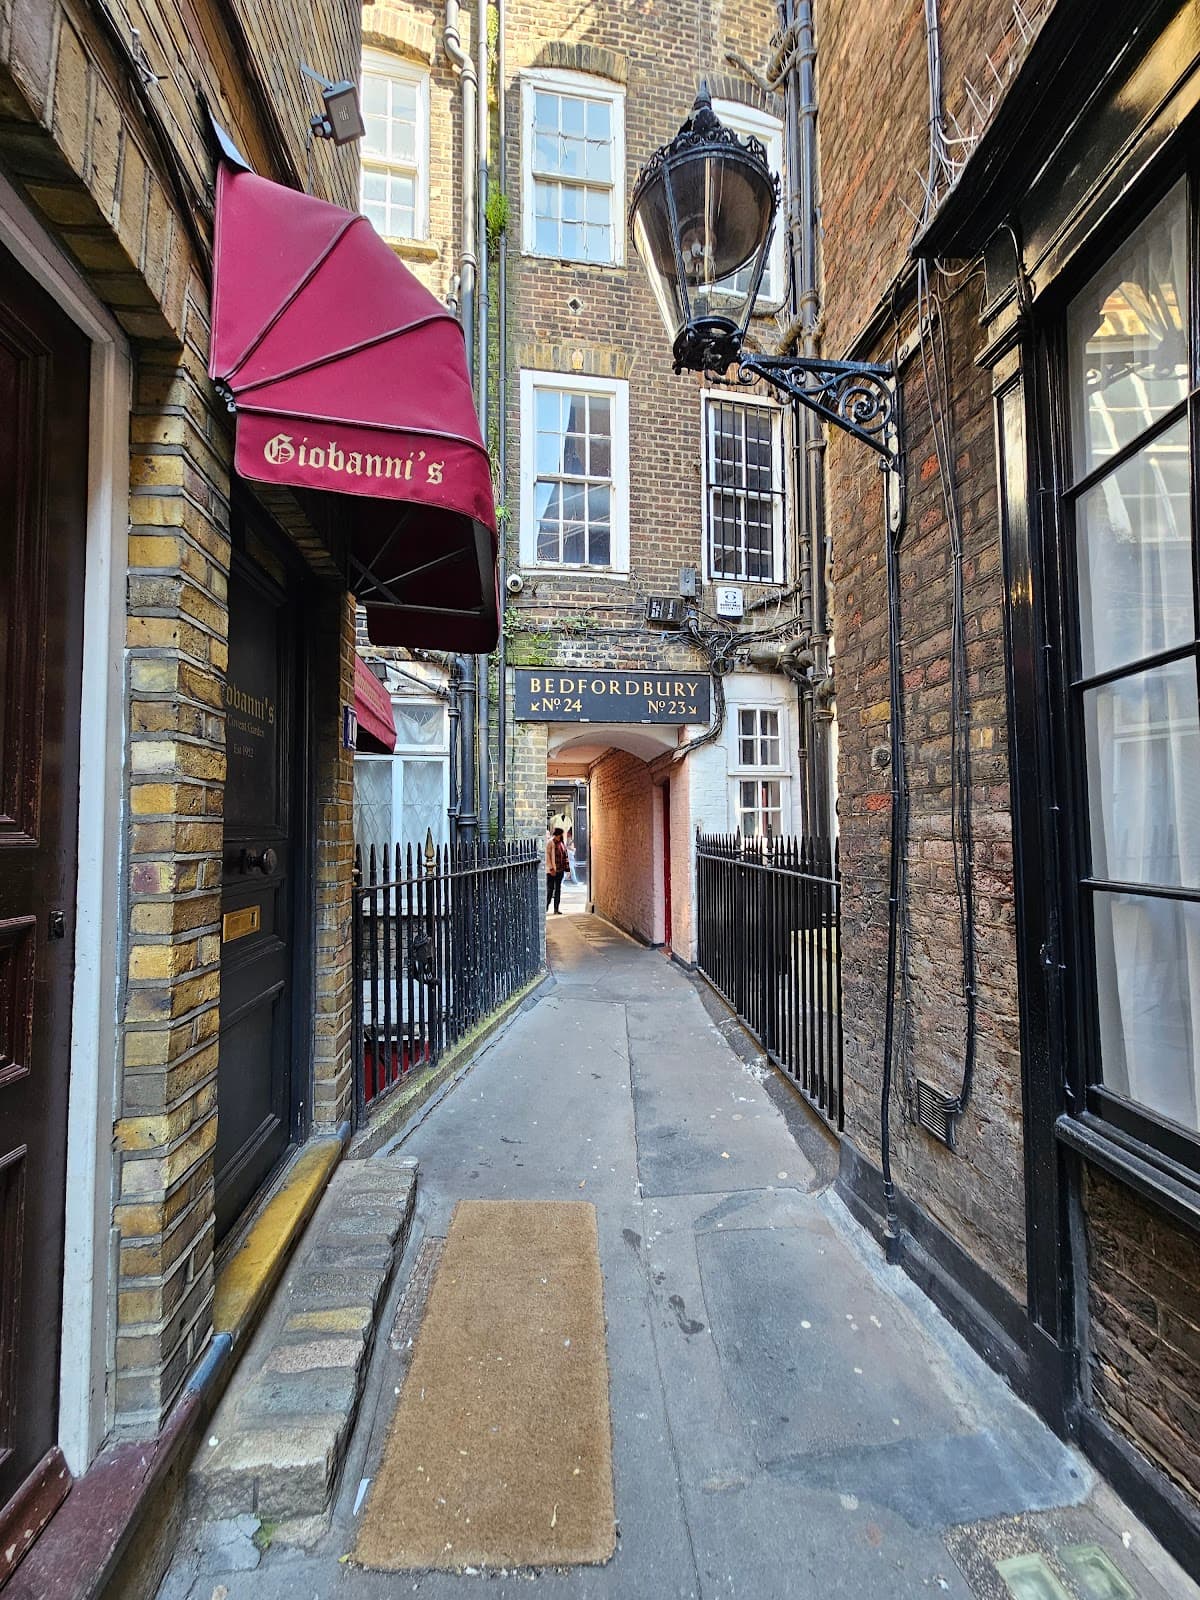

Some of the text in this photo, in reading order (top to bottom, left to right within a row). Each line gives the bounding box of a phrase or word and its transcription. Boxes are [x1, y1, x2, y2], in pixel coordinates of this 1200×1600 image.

[529, 677, 699, 697] BEDFORDBURY
[563, 698, 582, 713] 24
[667, 700, 687, 715] 23
